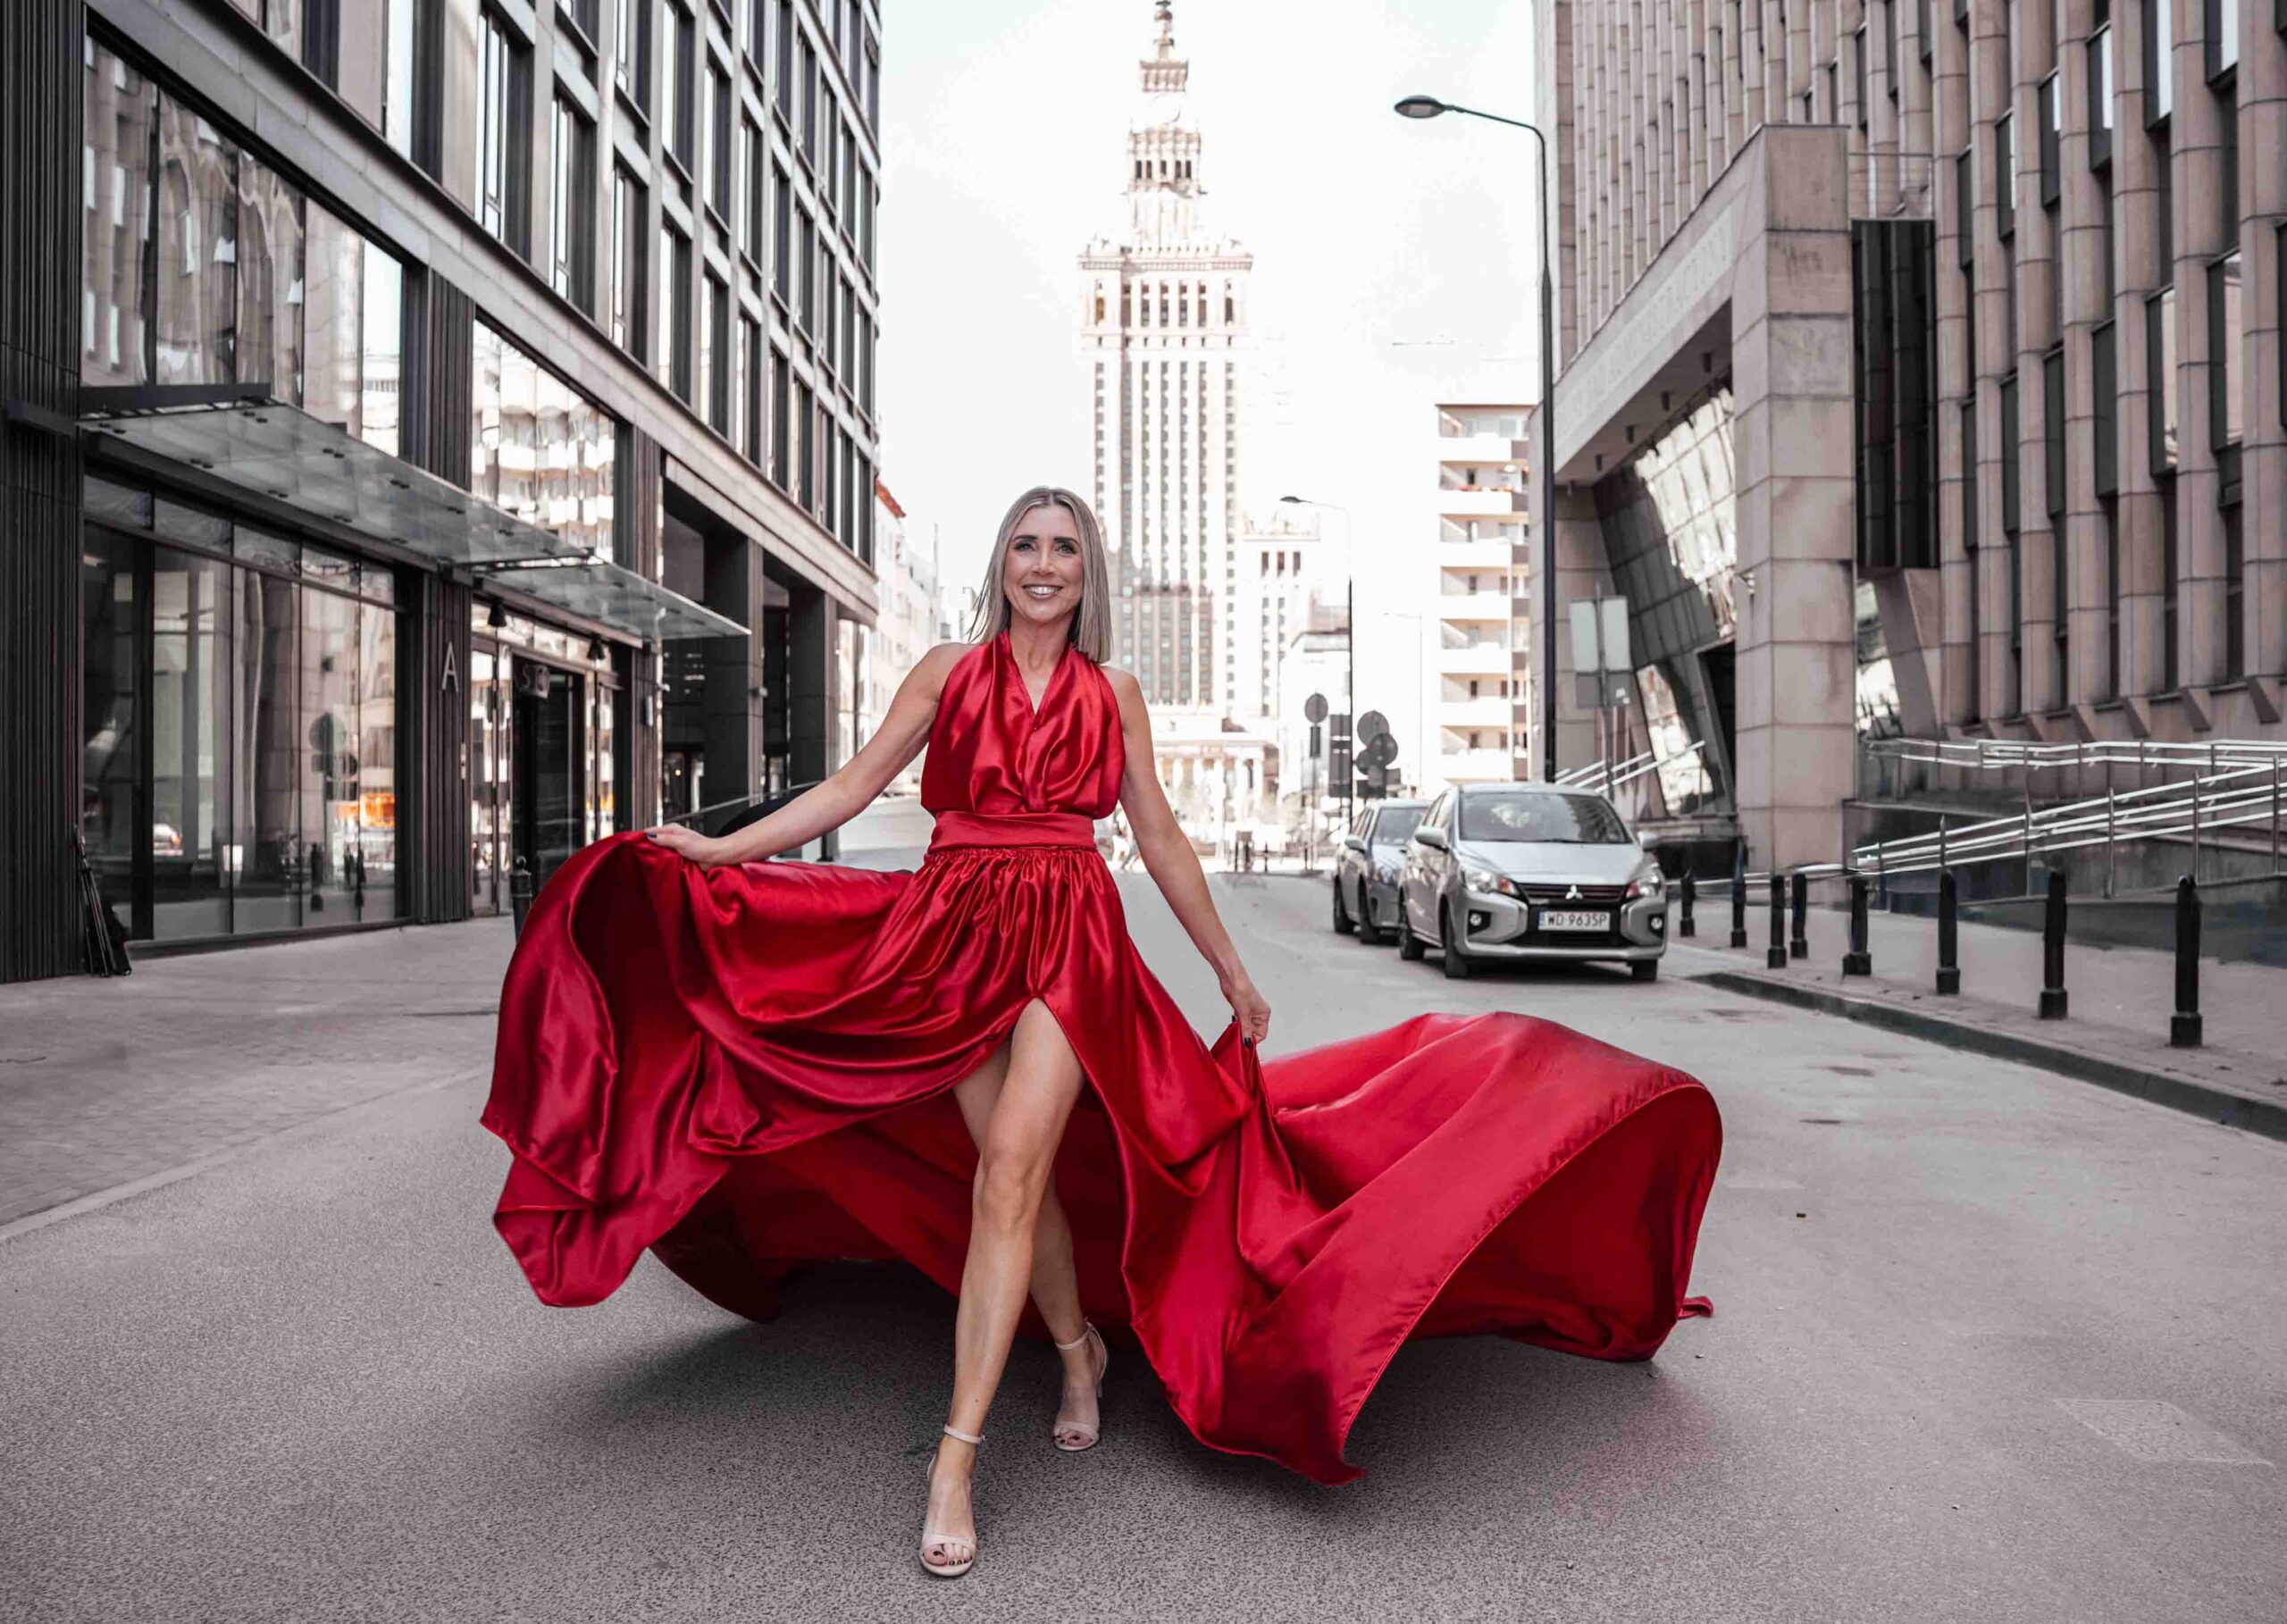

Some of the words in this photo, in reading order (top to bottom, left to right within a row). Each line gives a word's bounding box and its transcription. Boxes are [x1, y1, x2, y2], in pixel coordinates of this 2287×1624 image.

[441, 641, 459, 692] A
[1547, 913, 1564, 926] WD
[1569, 913, 1607, 927] 9635P
